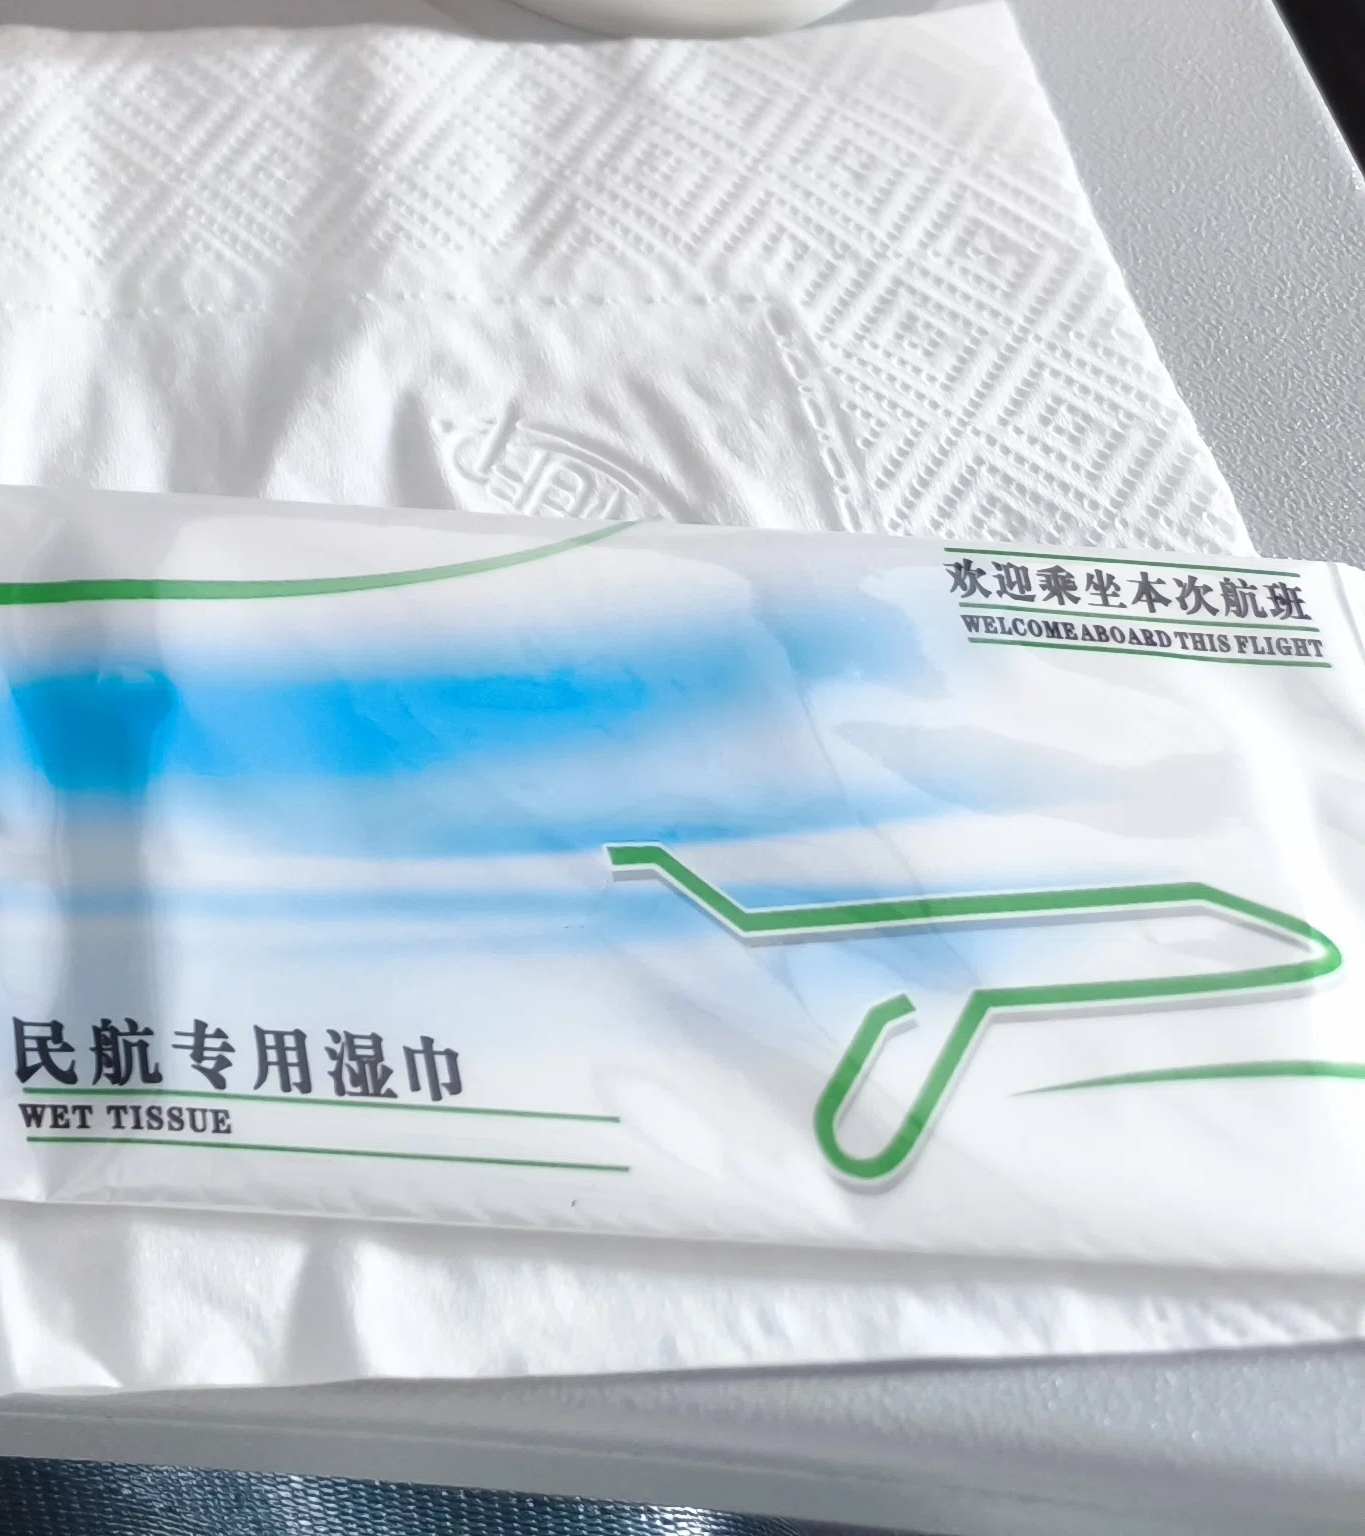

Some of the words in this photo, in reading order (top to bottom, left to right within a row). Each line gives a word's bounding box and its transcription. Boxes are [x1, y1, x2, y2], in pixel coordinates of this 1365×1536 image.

[943, 558, 1313, 621] 欢迎乘坐本次航班
[960, 614, 1076, 642] WELCOME
[1080, 622, 1173, 649] ABOARD
[1173, 630, 1232, 654] THIS
[1235, 635, 1325, 659] FLIGHT
[12, 1016, 464, 1102] 民航专用湿巾
[19, 1103, 93, 1130] WET
[106, 1104, 233, 1135] TISSUE
